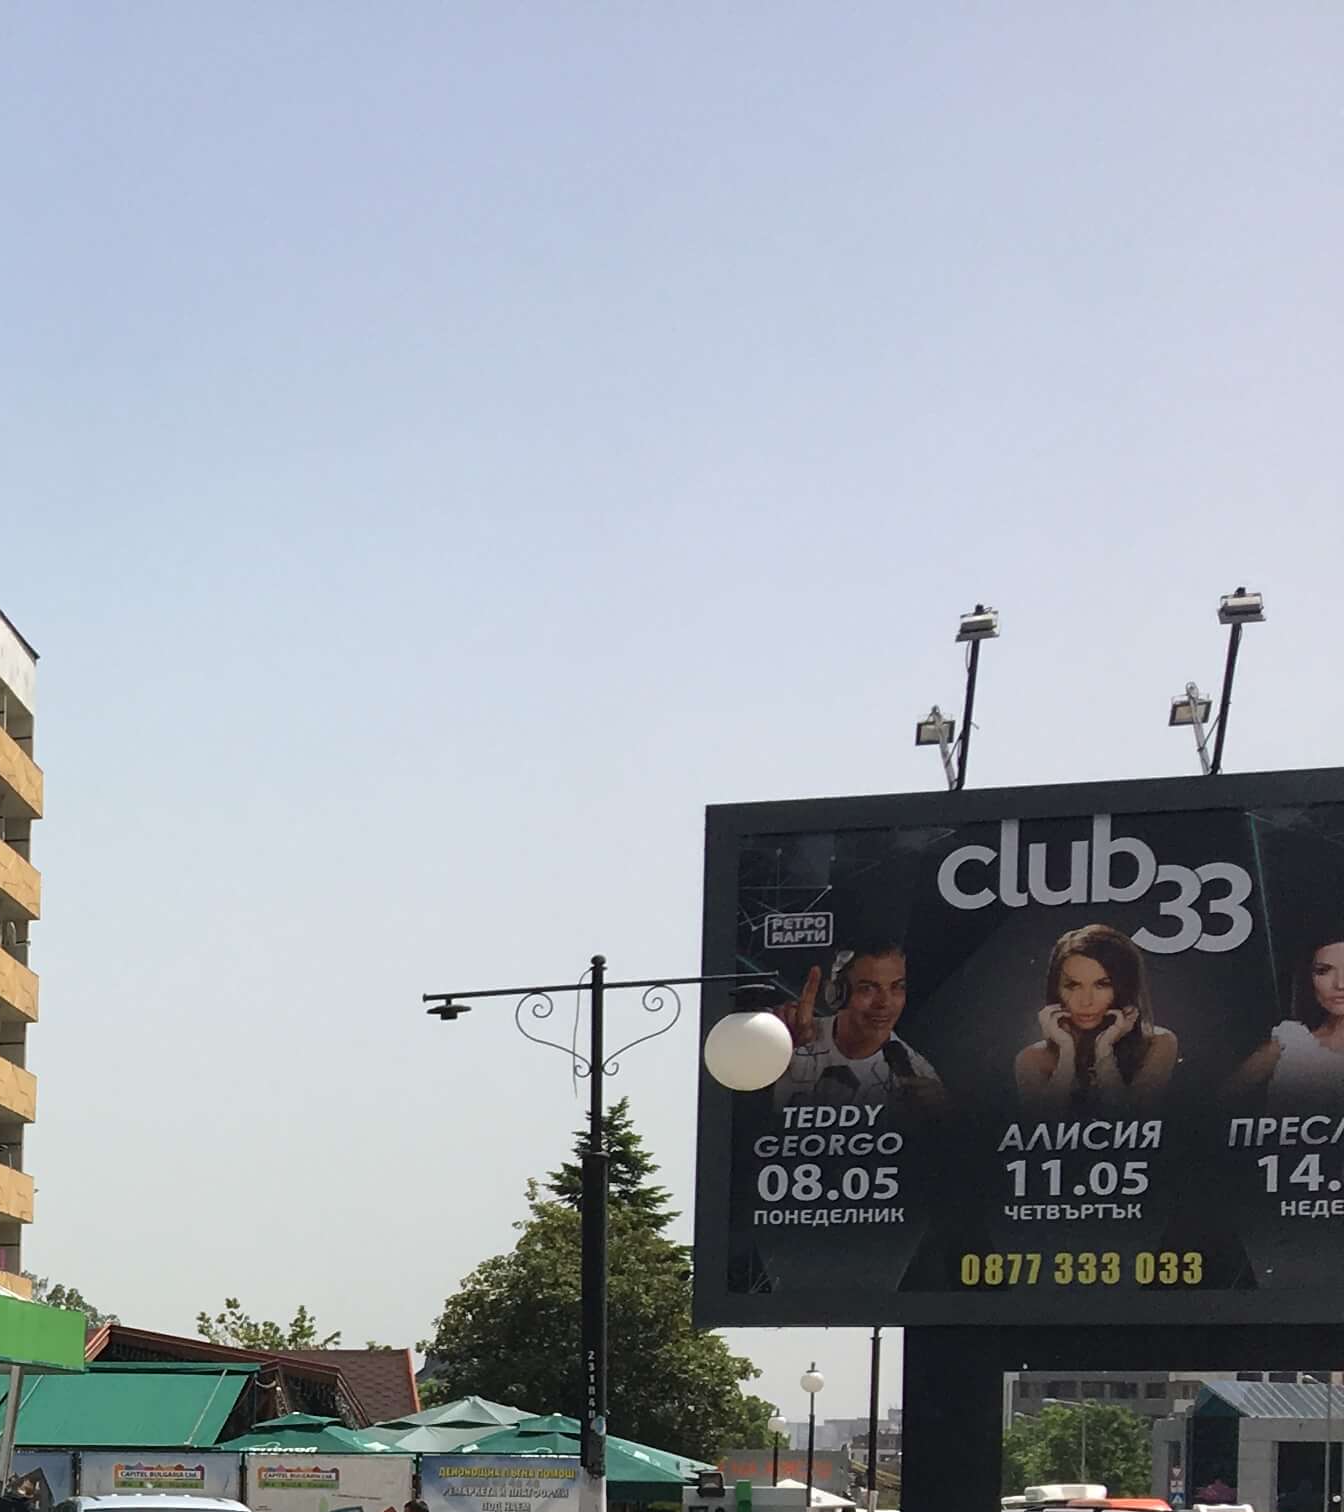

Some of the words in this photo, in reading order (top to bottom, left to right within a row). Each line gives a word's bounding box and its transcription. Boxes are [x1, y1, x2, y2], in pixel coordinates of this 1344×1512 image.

[783, 1104, 884, 1129] TEDDY
[754, 1132, 904, 1158] GEORGO
[997, 1120, 1162, 1152] АЛИСИЯ
[758, 1164, 900, 1202] 08.05
[1006, 1159, 1150, 1197] 11.05
[754, 1207, 905, 1227] ПОНЕДЕЛНИК
[1005, 1203, 1142, 1220] ЧЕТВЪРТЪК
[961, 1253, 1042, 1285] 0877
[1054, 1252, 1121, 1284] 333
[1135, 1251, 1203, 1284] 033
[482, 1502, 502, 1512] ПОД
